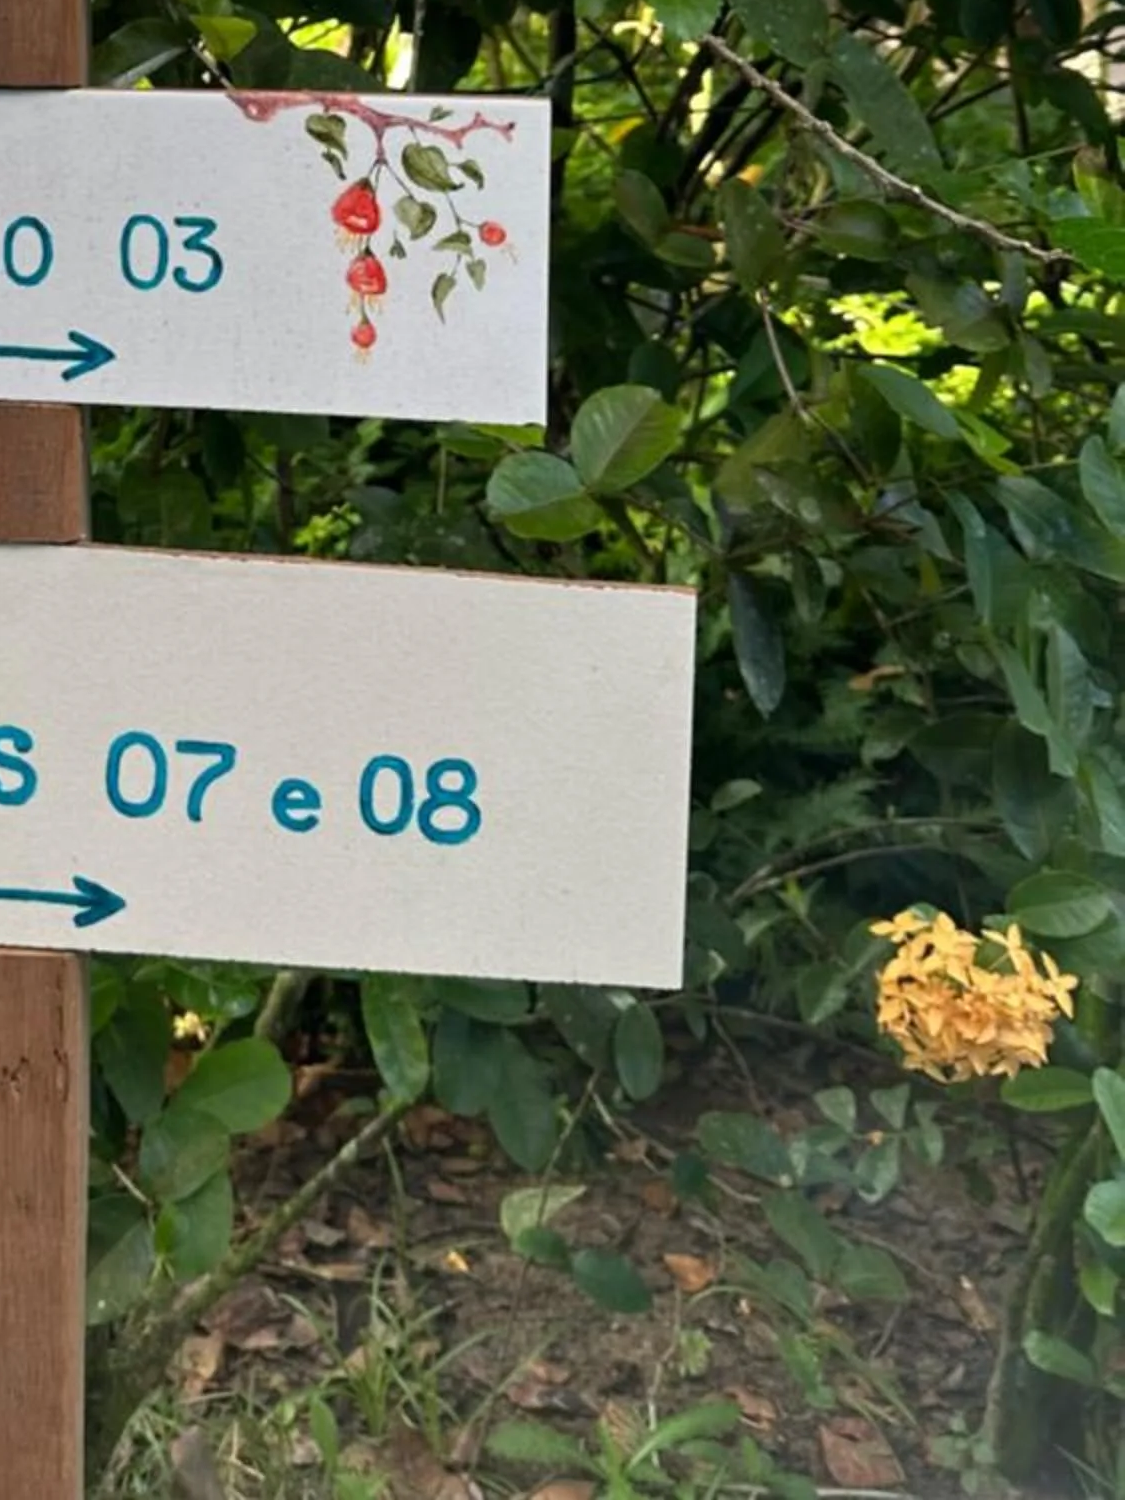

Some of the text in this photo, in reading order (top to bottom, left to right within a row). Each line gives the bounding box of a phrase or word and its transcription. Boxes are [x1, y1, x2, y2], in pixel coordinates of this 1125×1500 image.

[120, 214, 223, 293] 03
[105, 731, 237, 822] 07
[271, 778, 322, 833] e
[359, 754, 482, 846] 08
